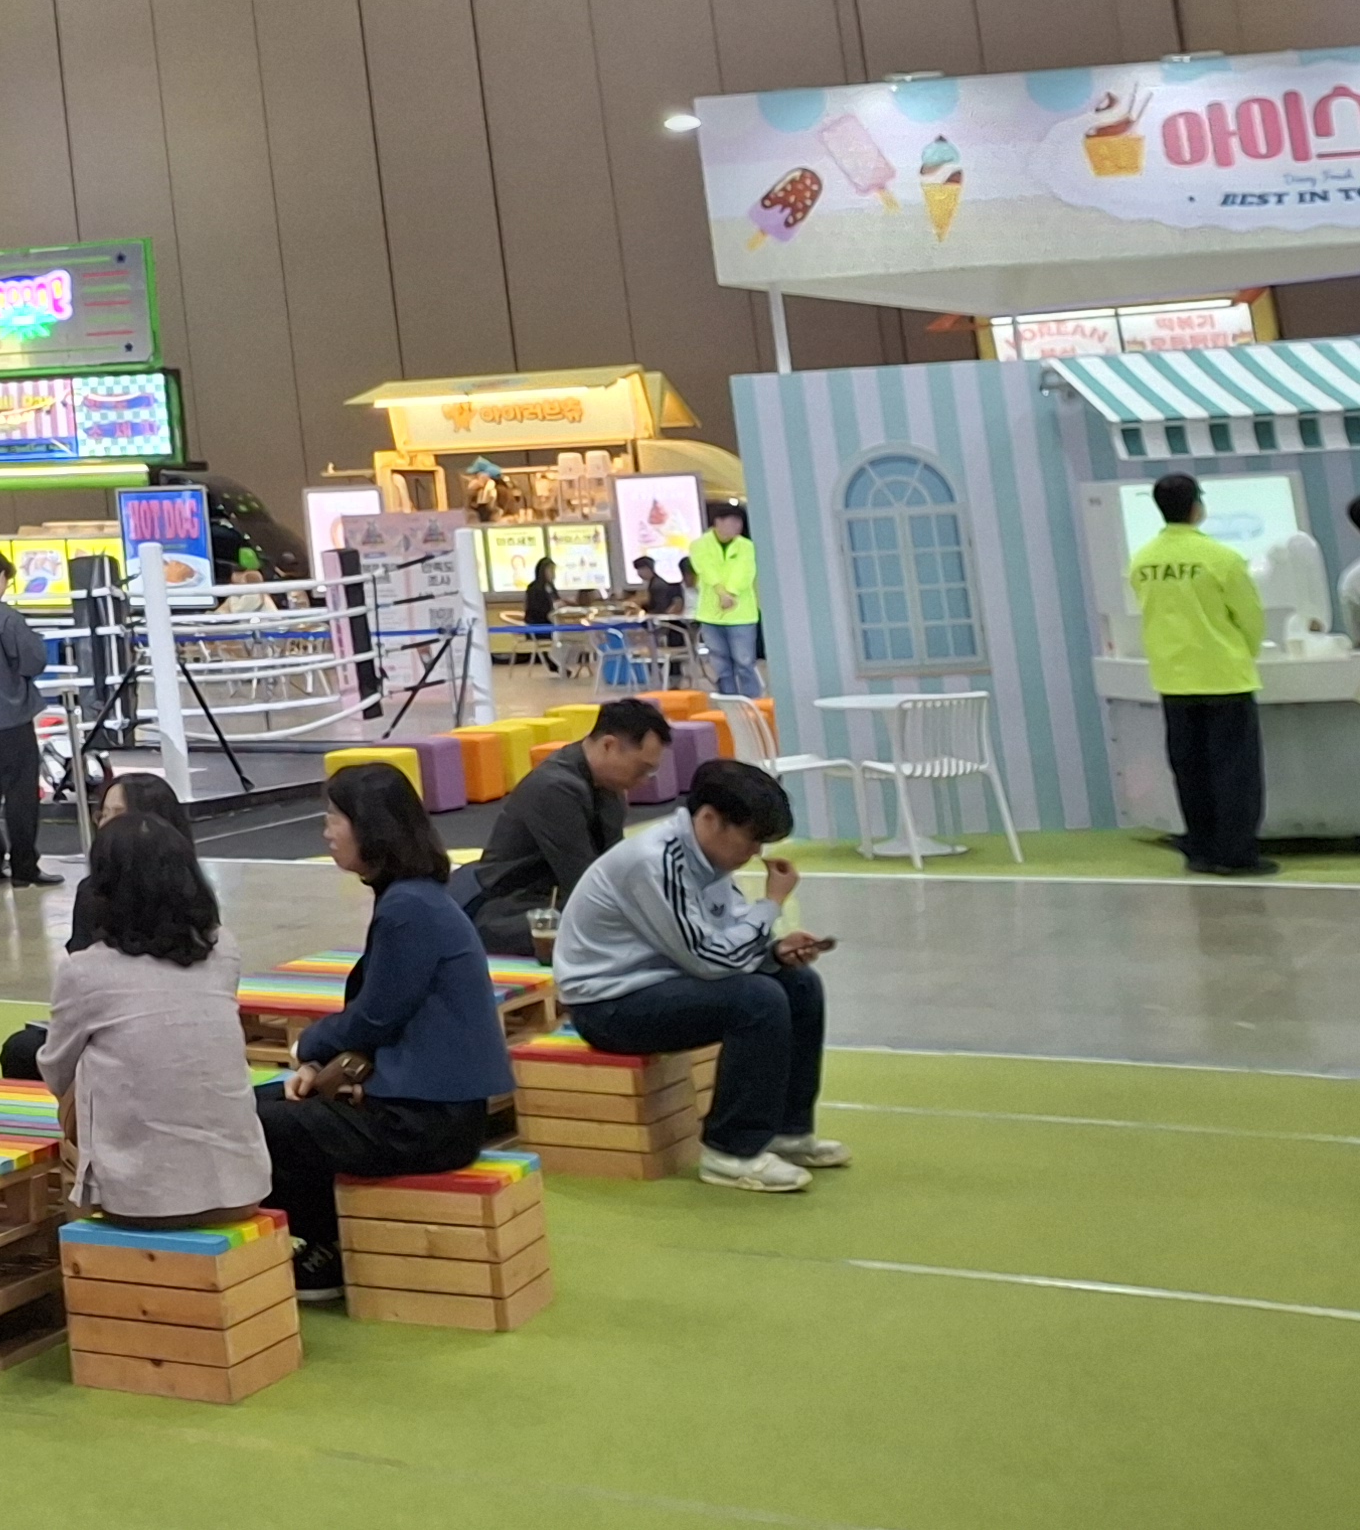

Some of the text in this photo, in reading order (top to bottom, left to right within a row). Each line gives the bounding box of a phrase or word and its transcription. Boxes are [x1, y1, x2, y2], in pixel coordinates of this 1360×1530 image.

[1220, 187, 1360, 207] BEST IN T
[128, 498, 199, 540] HOT DOG
[1139, 562, 1203, 581] STAFF
